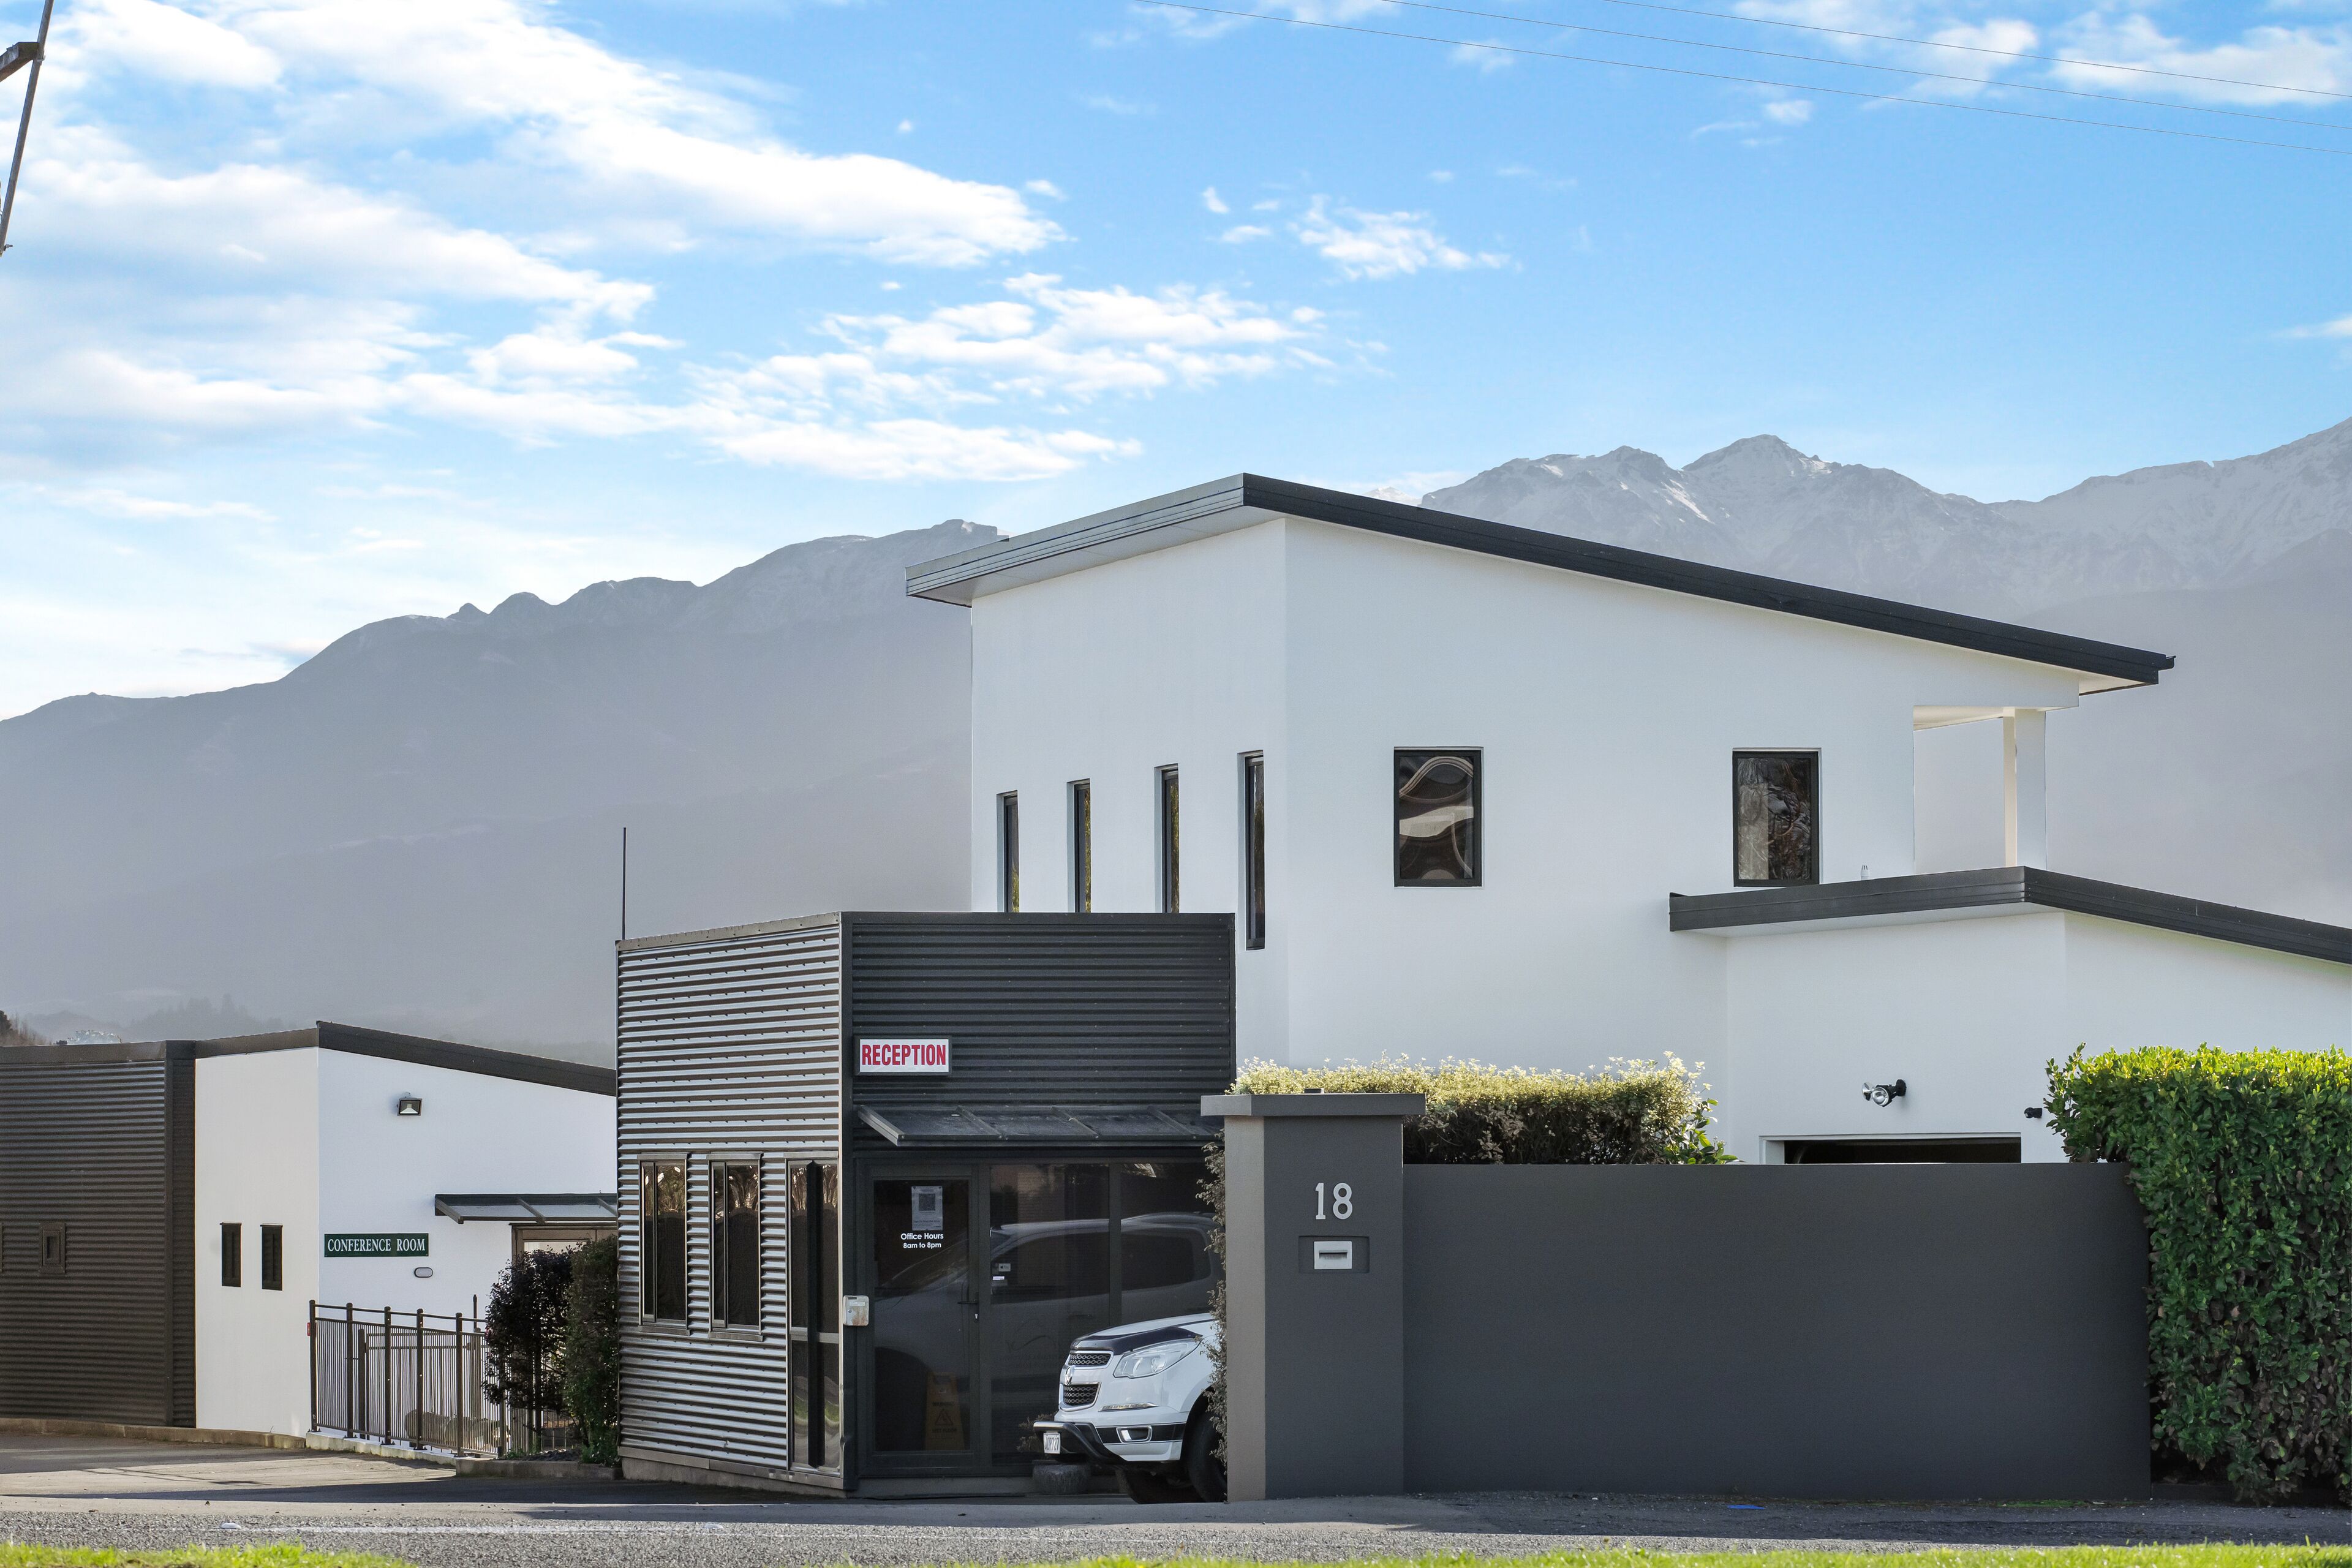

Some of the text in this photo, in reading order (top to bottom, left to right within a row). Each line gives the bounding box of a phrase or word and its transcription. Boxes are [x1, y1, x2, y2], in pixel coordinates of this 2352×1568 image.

[862, 1044, 946, 1066] RECEPTION
[1315, 1182, 1353, 1220] 18
[328, 1238, 425, 1251] CONFERENCE ROOM
